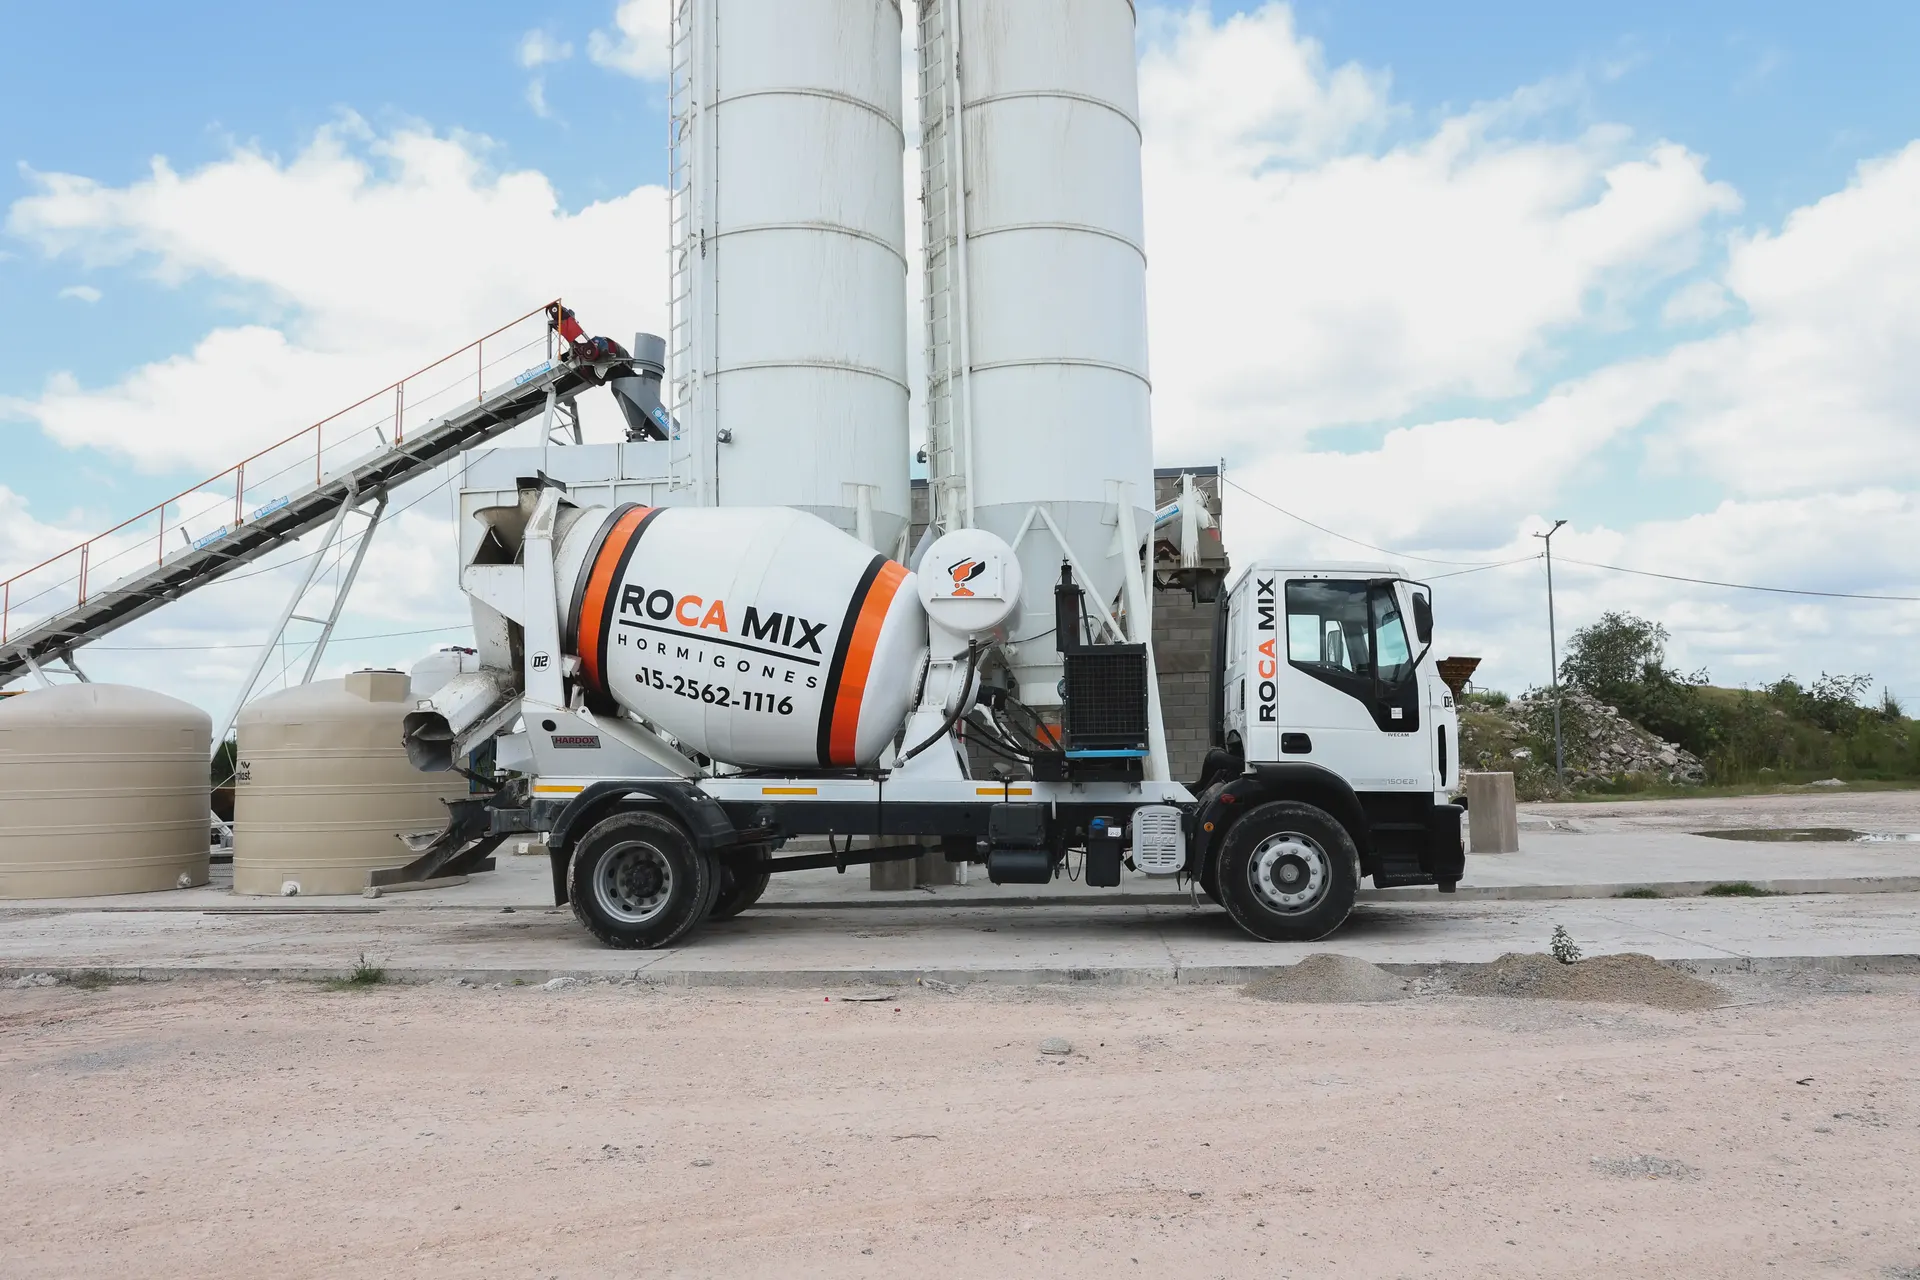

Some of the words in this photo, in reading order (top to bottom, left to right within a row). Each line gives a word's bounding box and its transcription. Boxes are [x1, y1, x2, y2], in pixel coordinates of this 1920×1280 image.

[619, 584, 729, 633] ROCA
[741, 605, 828, 655] MIX
[1257, 577, 1275, 630] MIX
[617, 633, 818, 689] HORMIGONES
[1258, 638, 1276, 722] ROCA
[641, 666, 794, 716] 15-2562-1116
[1142, 836, 1176, 845] IVECO
